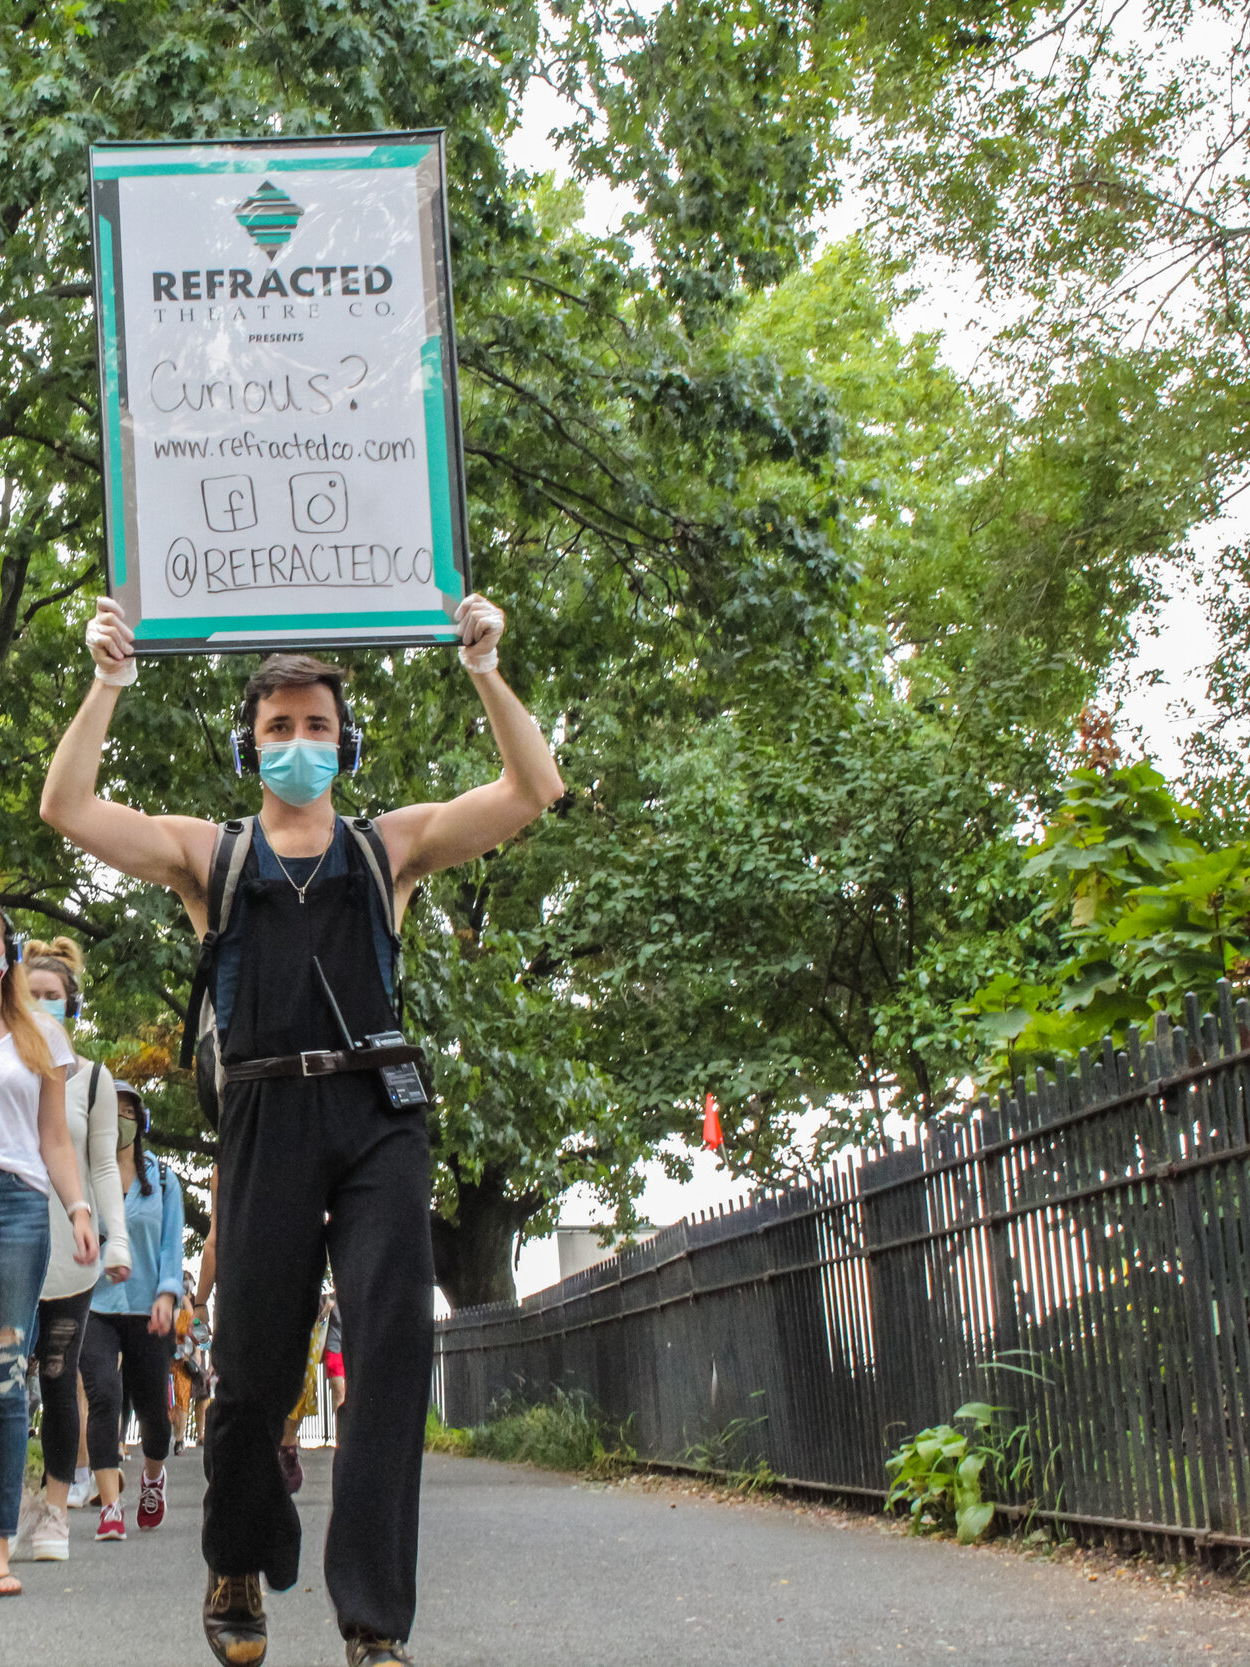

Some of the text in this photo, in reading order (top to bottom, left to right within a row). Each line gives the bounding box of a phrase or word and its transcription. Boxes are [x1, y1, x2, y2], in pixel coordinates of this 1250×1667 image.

[152, 265, 393, 301] REFRACTED
[154, 301, 396, 323] THEATRE CO.
[248, 332, 304, 343] PRESENTS
[151, 355, 369, 414] Curious?
[154, 430, 415, 462] www.refractedco.com
[165, 537, 434, 598] @REFRACTEDCO
